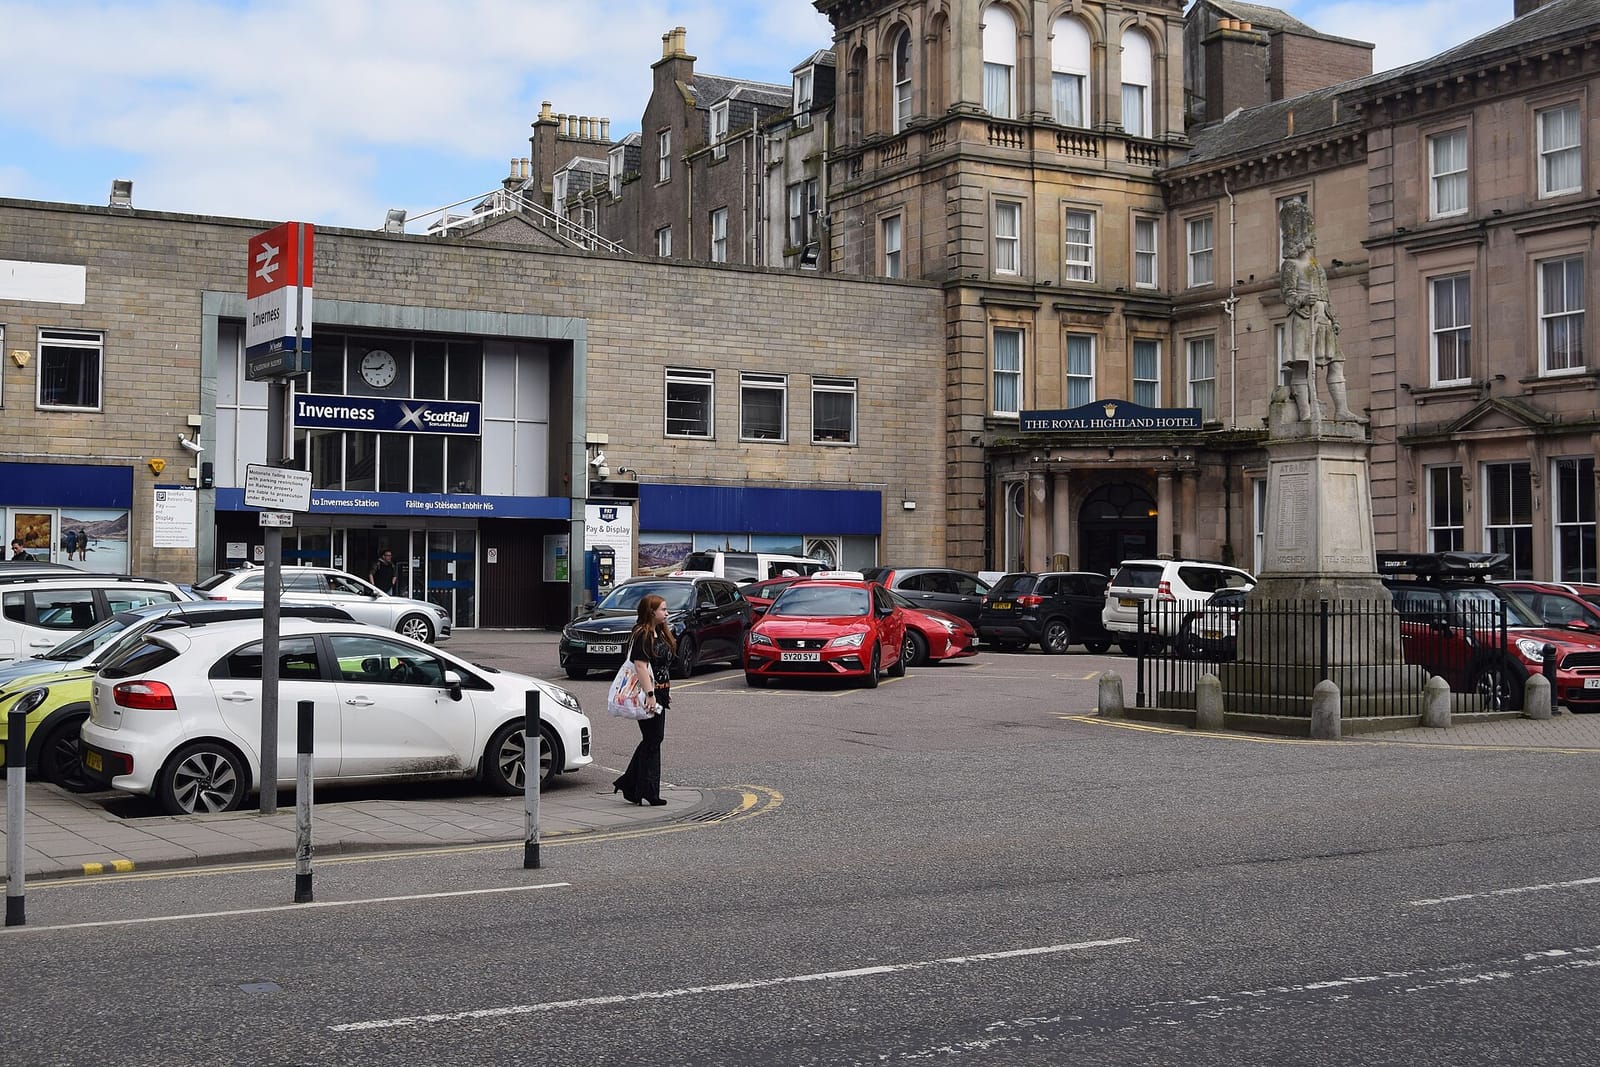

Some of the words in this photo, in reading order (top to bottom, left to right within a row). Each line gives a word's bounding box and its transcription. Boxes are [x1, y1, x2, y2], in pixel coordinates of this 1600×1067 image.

[252, 306, 280, 327] Inverness
[298, 402, 375, 420] Inverness
[423, 410, 470, 423] ScotRail
[1025, 420, 1049, 429] THE
[1052, 420, 1088, 428] ROYAL
[1090, 418, 1153, 428] HIGHLAND
[1156, 418, 1197, 427] HOTEL
[406, 500, 424, 508] Fàilte
[586, 525, 597, 534] Pay
[606, 526, 630, 535] Display
